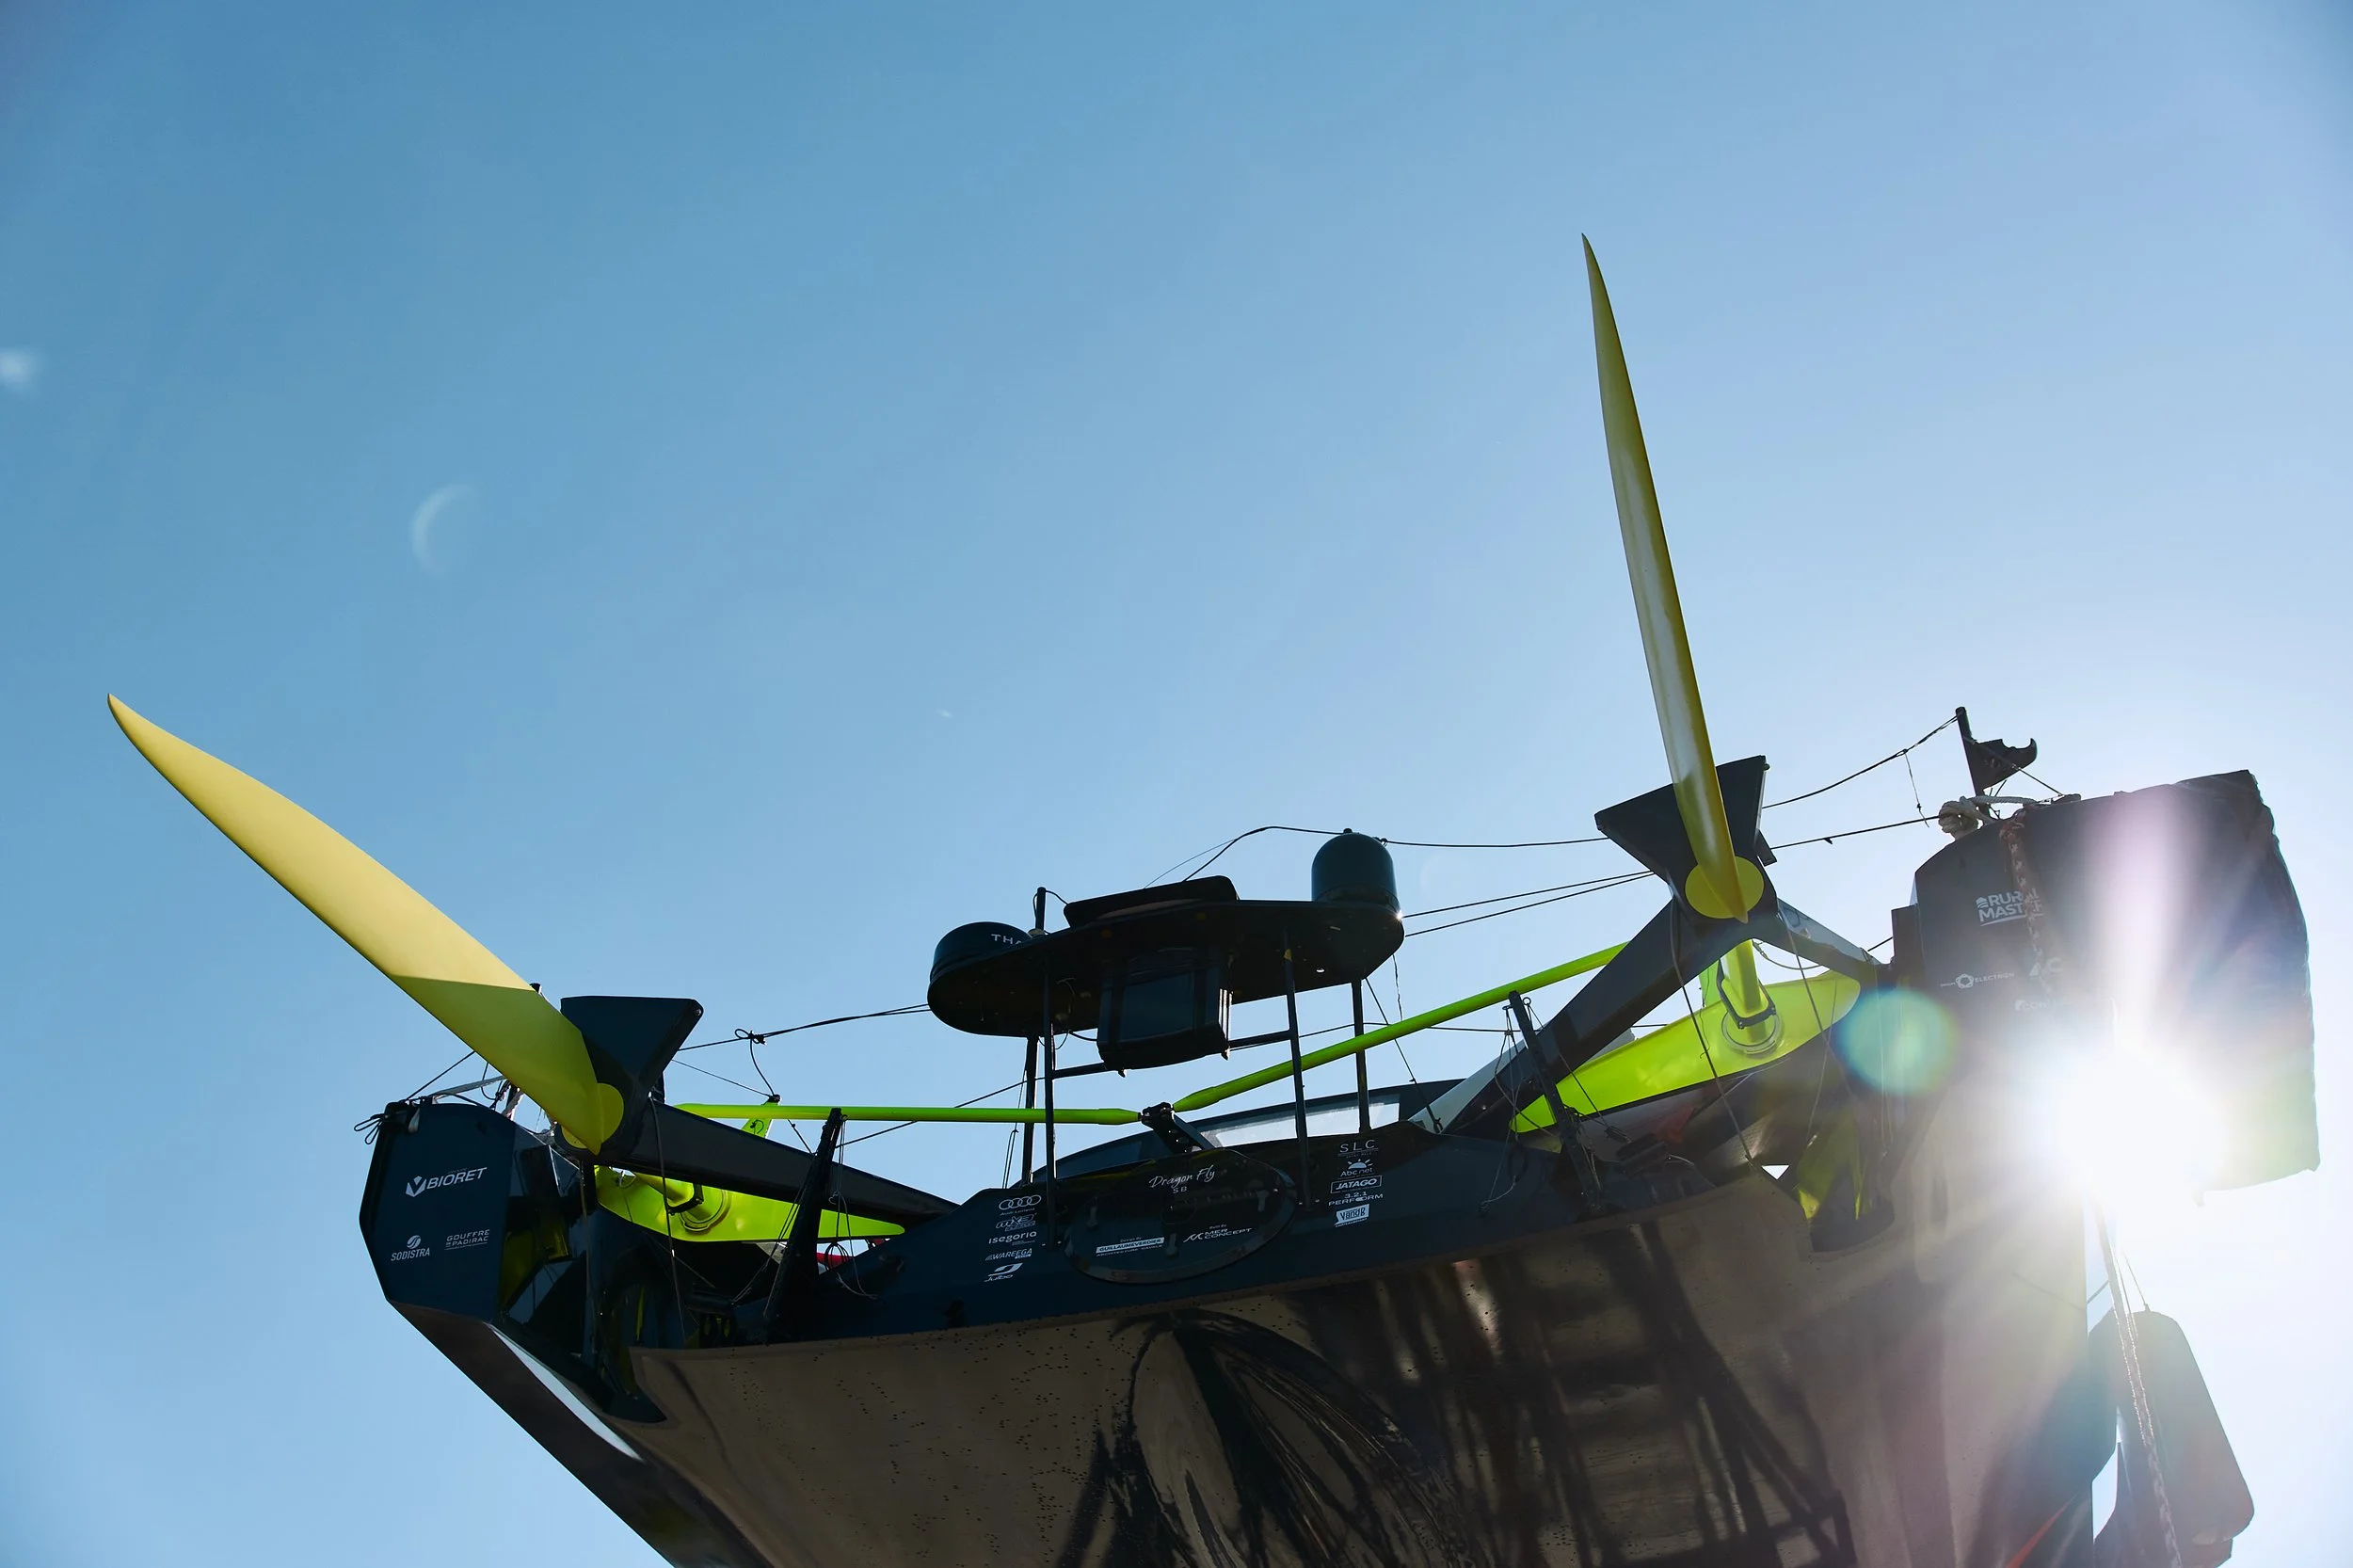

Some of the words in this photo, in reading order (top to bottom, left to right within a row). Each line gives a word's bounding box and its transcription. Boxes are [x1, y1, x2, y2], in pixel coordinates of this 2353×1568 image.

[1988, 888, 2039, 906] RURL
[1978, 901, 2042, 922] MASTR
[426, 1166, 488, 1190] BIORET
[1148, 1175, 1193, 1189] Dragon
[1196, 1164, 1215, 1183] Fly
[446, 1229, 490, 1242] GOUFFRE
[451, 1235, 488, 1247] PADIRAC
[1204, 1227, 1253, 1240] CONCEPT
[391, 1247, 430, 1261] SODISTRA
